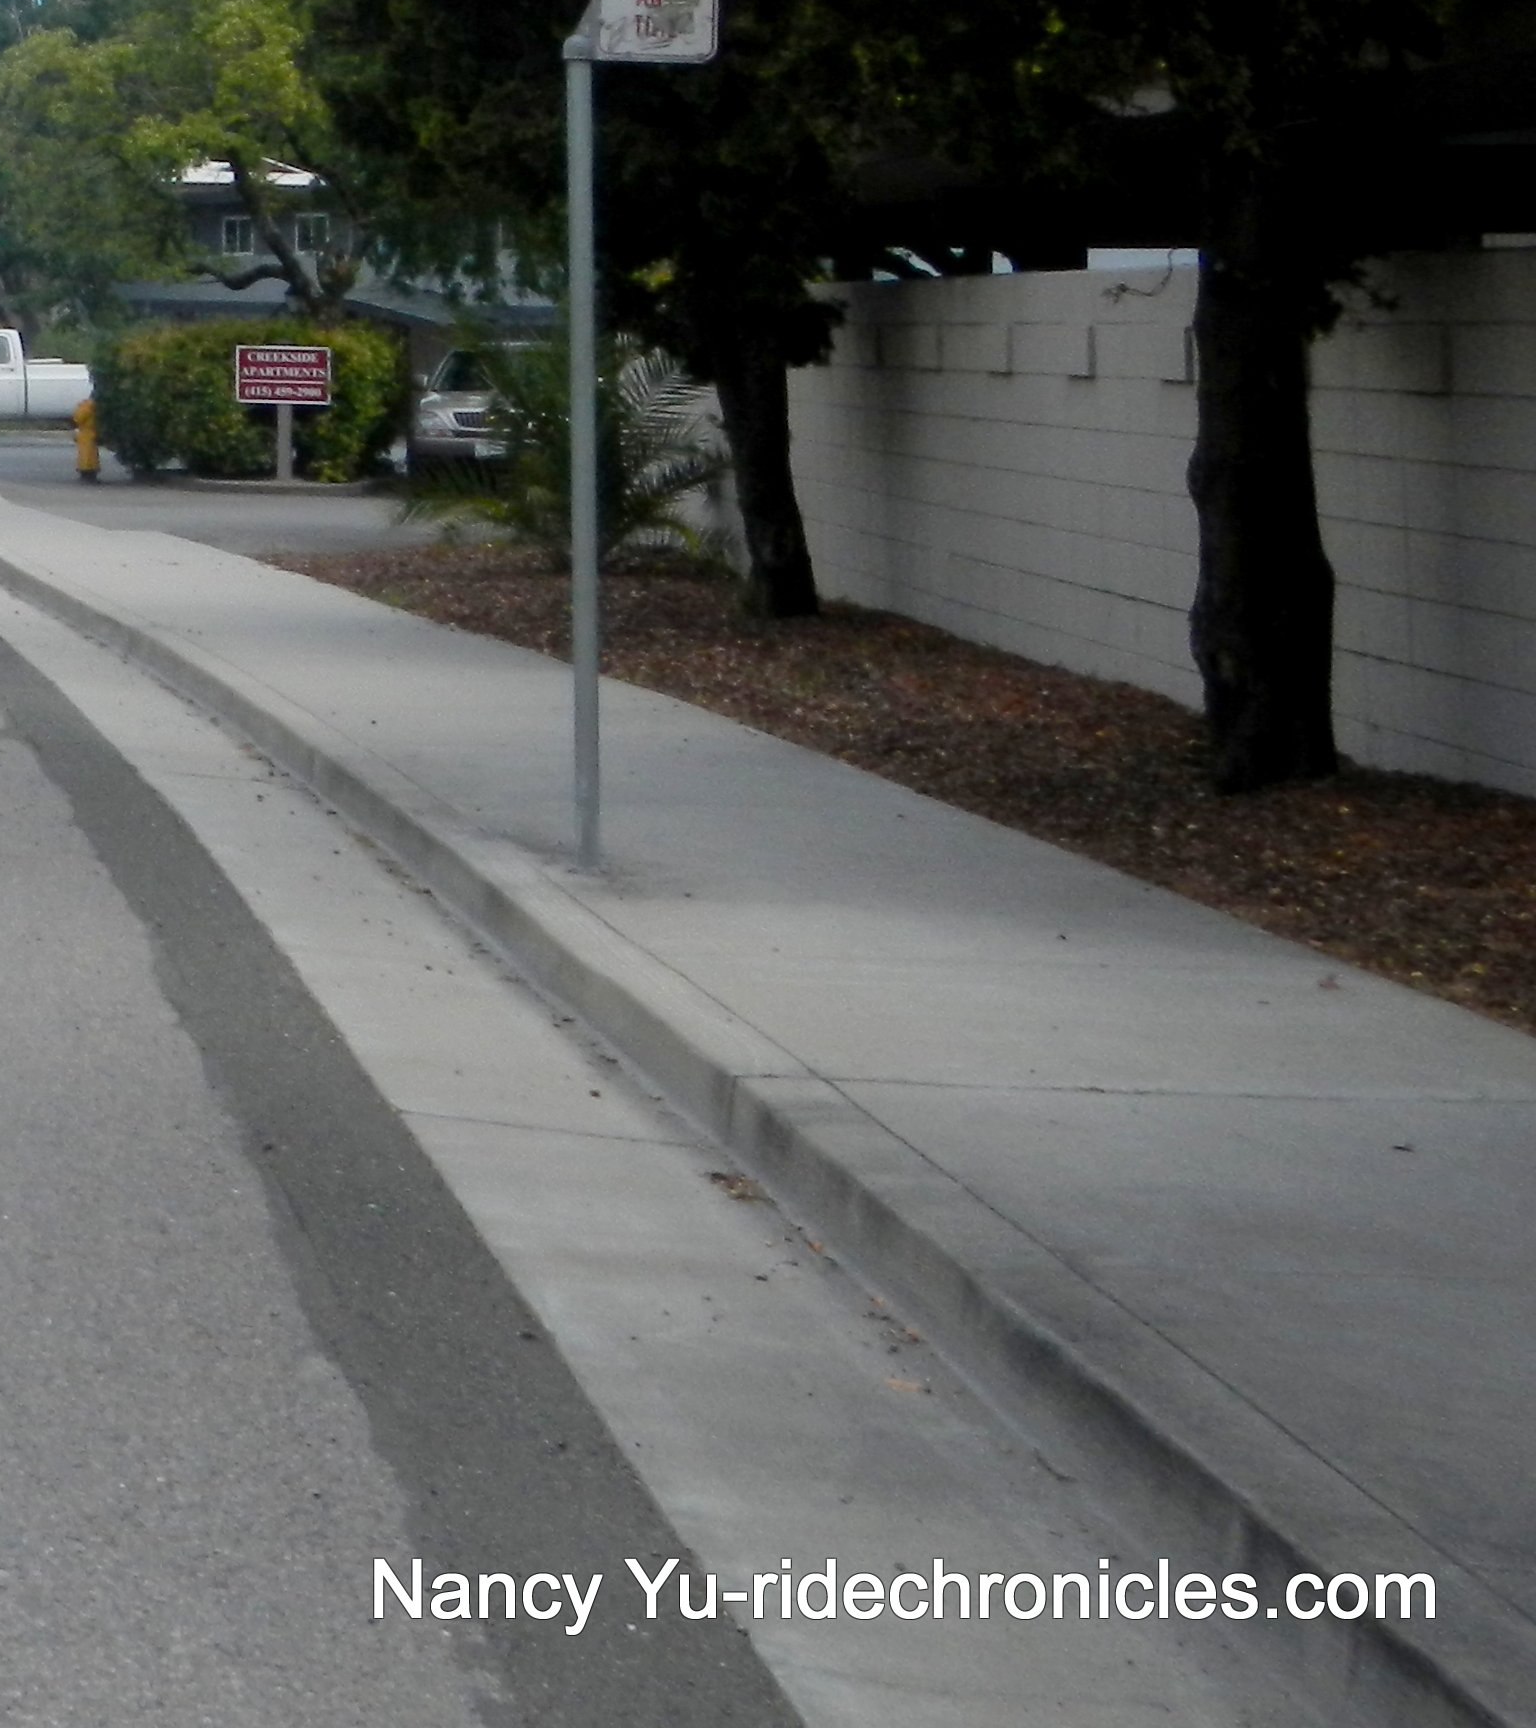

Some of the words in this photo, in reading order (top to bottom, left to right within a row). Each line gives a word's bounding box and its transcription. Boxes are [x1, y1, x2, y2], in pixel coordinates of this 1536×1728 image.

[247, 351, 318, 363] CREEKSIDE
[241, 366, 326, 378] APARTMENTS
[244, 385, 272, 398] (415)
